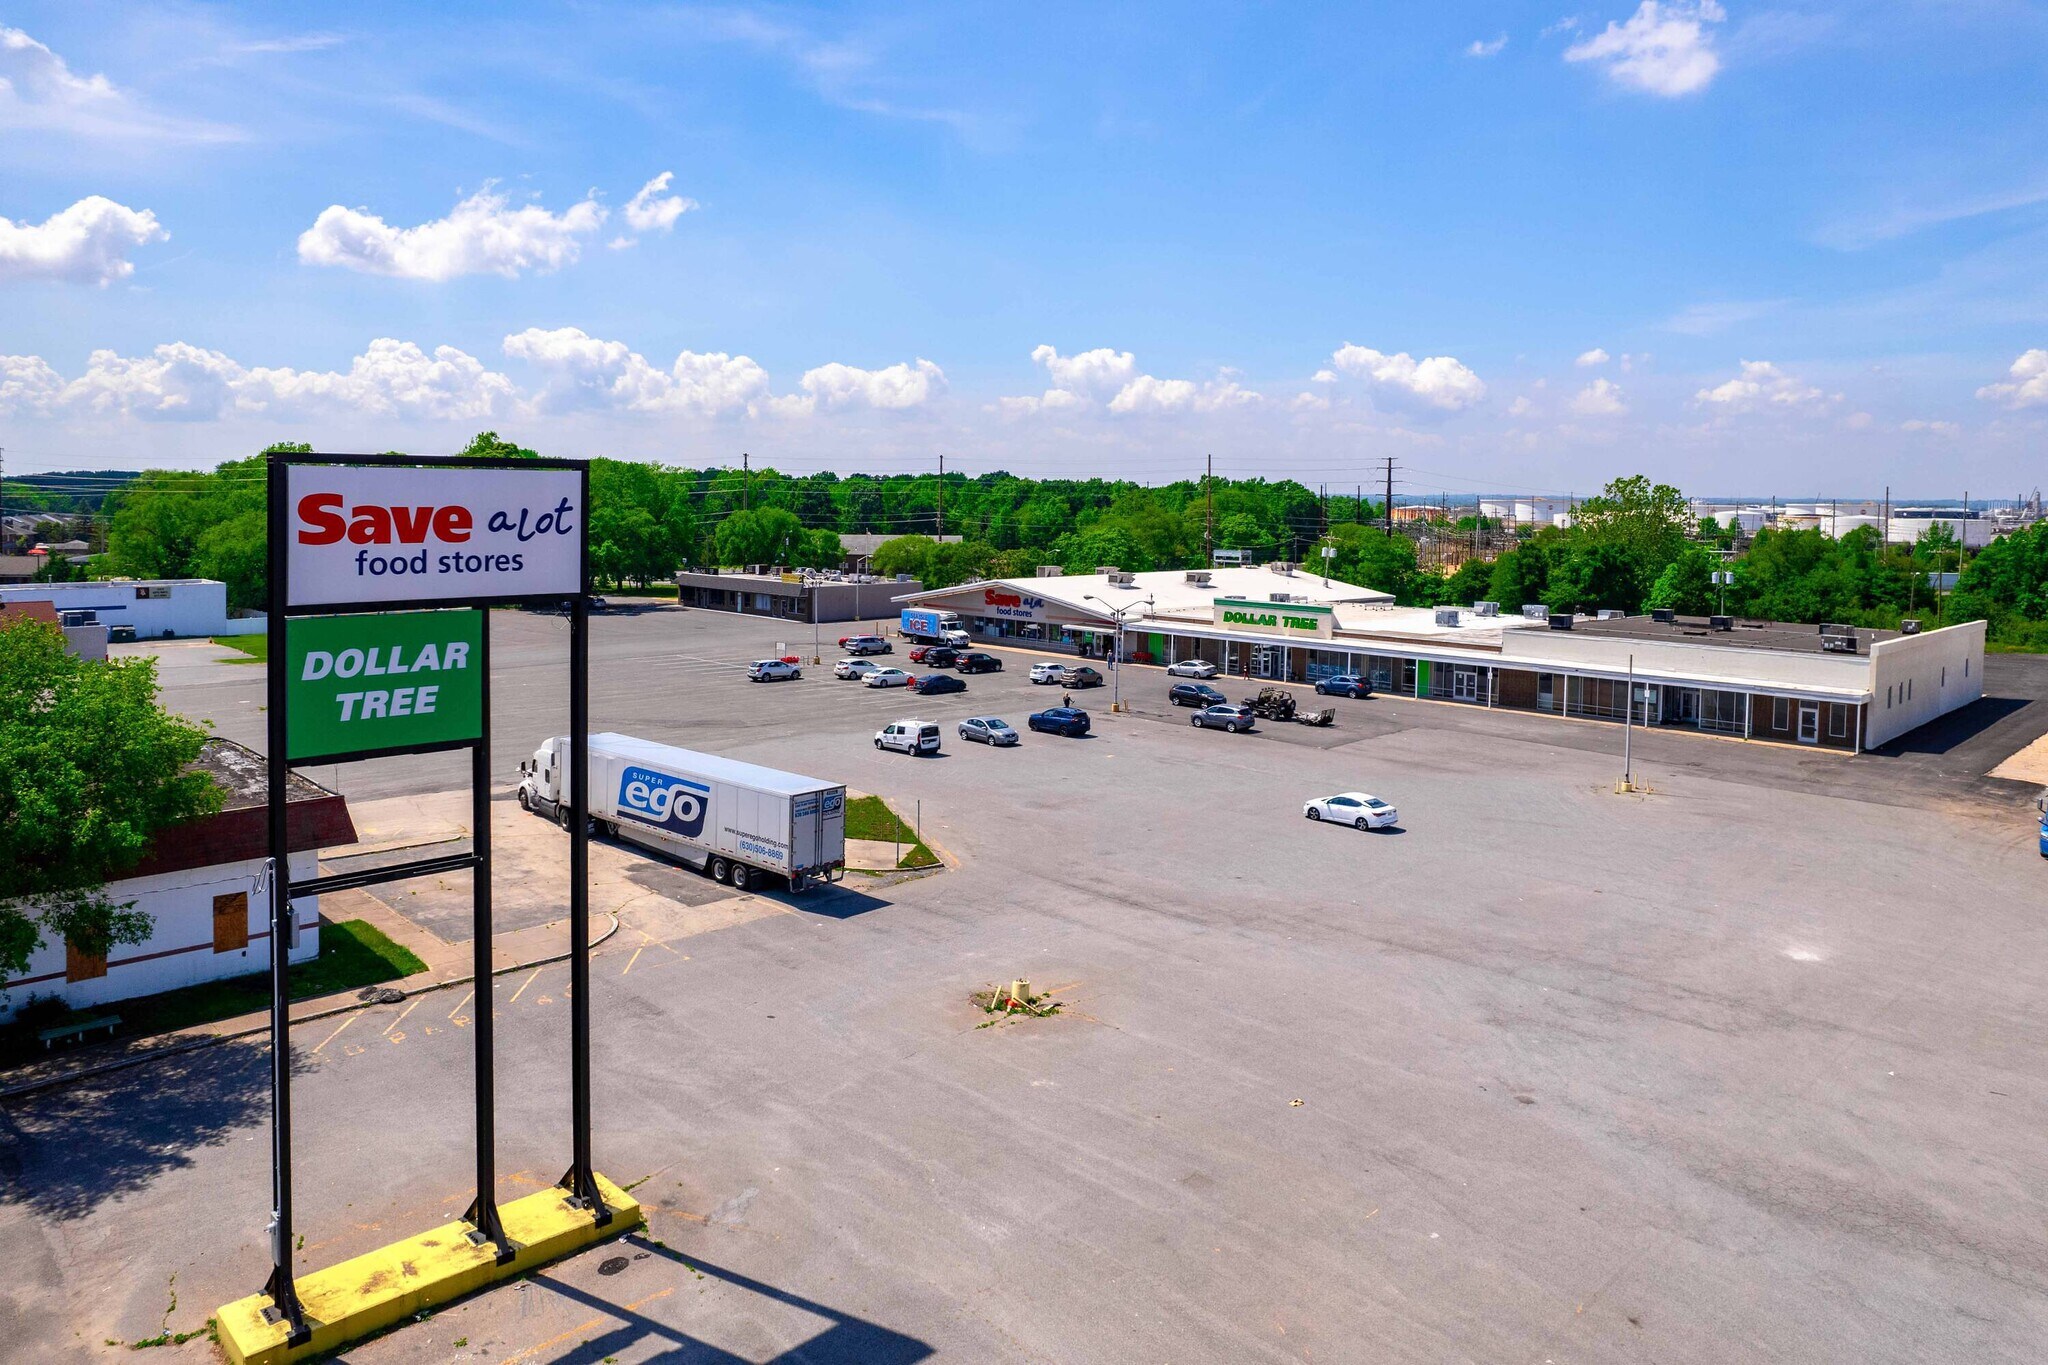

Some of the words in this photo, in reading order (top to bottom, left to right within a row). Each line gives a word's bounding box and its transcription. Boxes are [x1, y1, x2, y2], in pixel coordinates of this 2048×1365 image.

[297, 493, 473, 545] Save
[355, 549, 427, 576] food
[438, 552, 523, 574] stores
[985, 588, 1021, 608] Save
[996, 606, 1012, 616] food
[1012, 609, 1032, 618] stores
[1223, 611, 1277, 627] DOLLAR
[1282, 616, 1318, 630] TREE
[910, 619, 928, 632] ICE
[301, 641, 470, 681] DOLLAR
[335, 685, 440, 722] TREE
[632, 772, 663, 786] SUPER
[625, 781, 701, 822] ego
[724, 826, 789, 849] www.superegoholding.com
